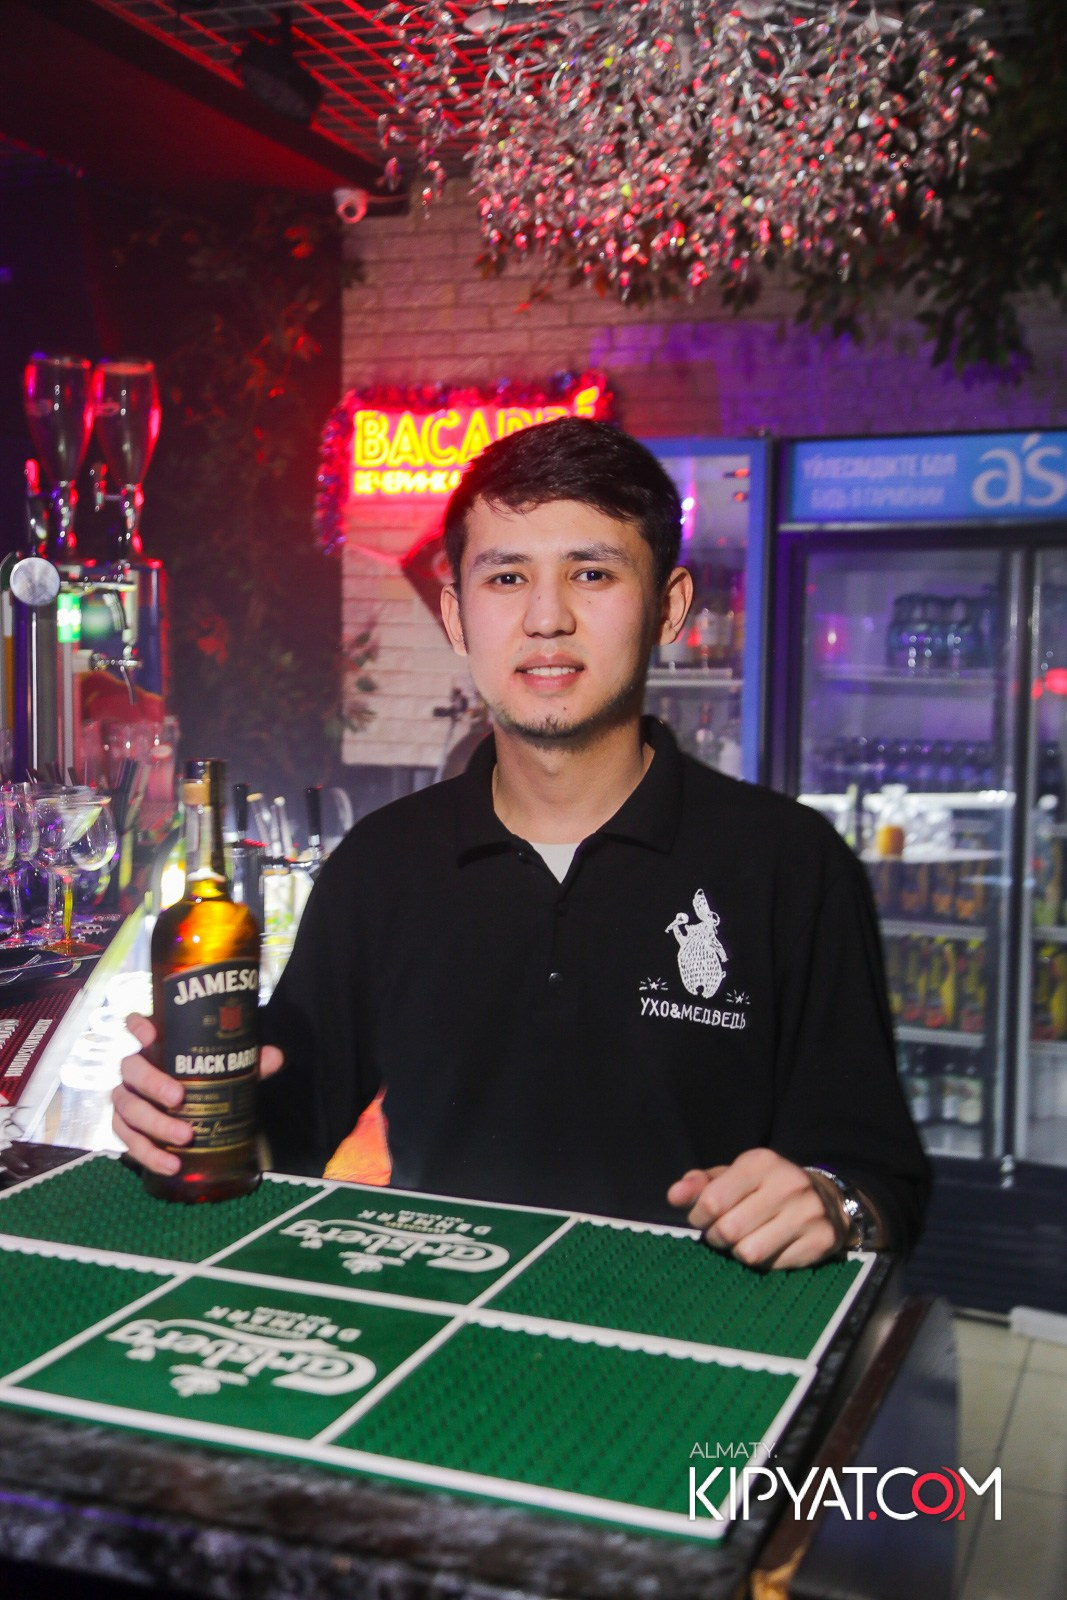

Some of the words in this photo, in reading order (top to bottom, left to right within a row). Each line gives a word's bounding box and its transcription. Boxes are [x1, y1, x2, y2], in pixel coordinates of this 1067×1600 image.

[354, 386, 599, 466] BACA
[175, 1054, 225, 1075] BLACK
[279, 1219, 510, 1273] Carlsberg
[105, 1318, 377, 1396] Carlsberg
